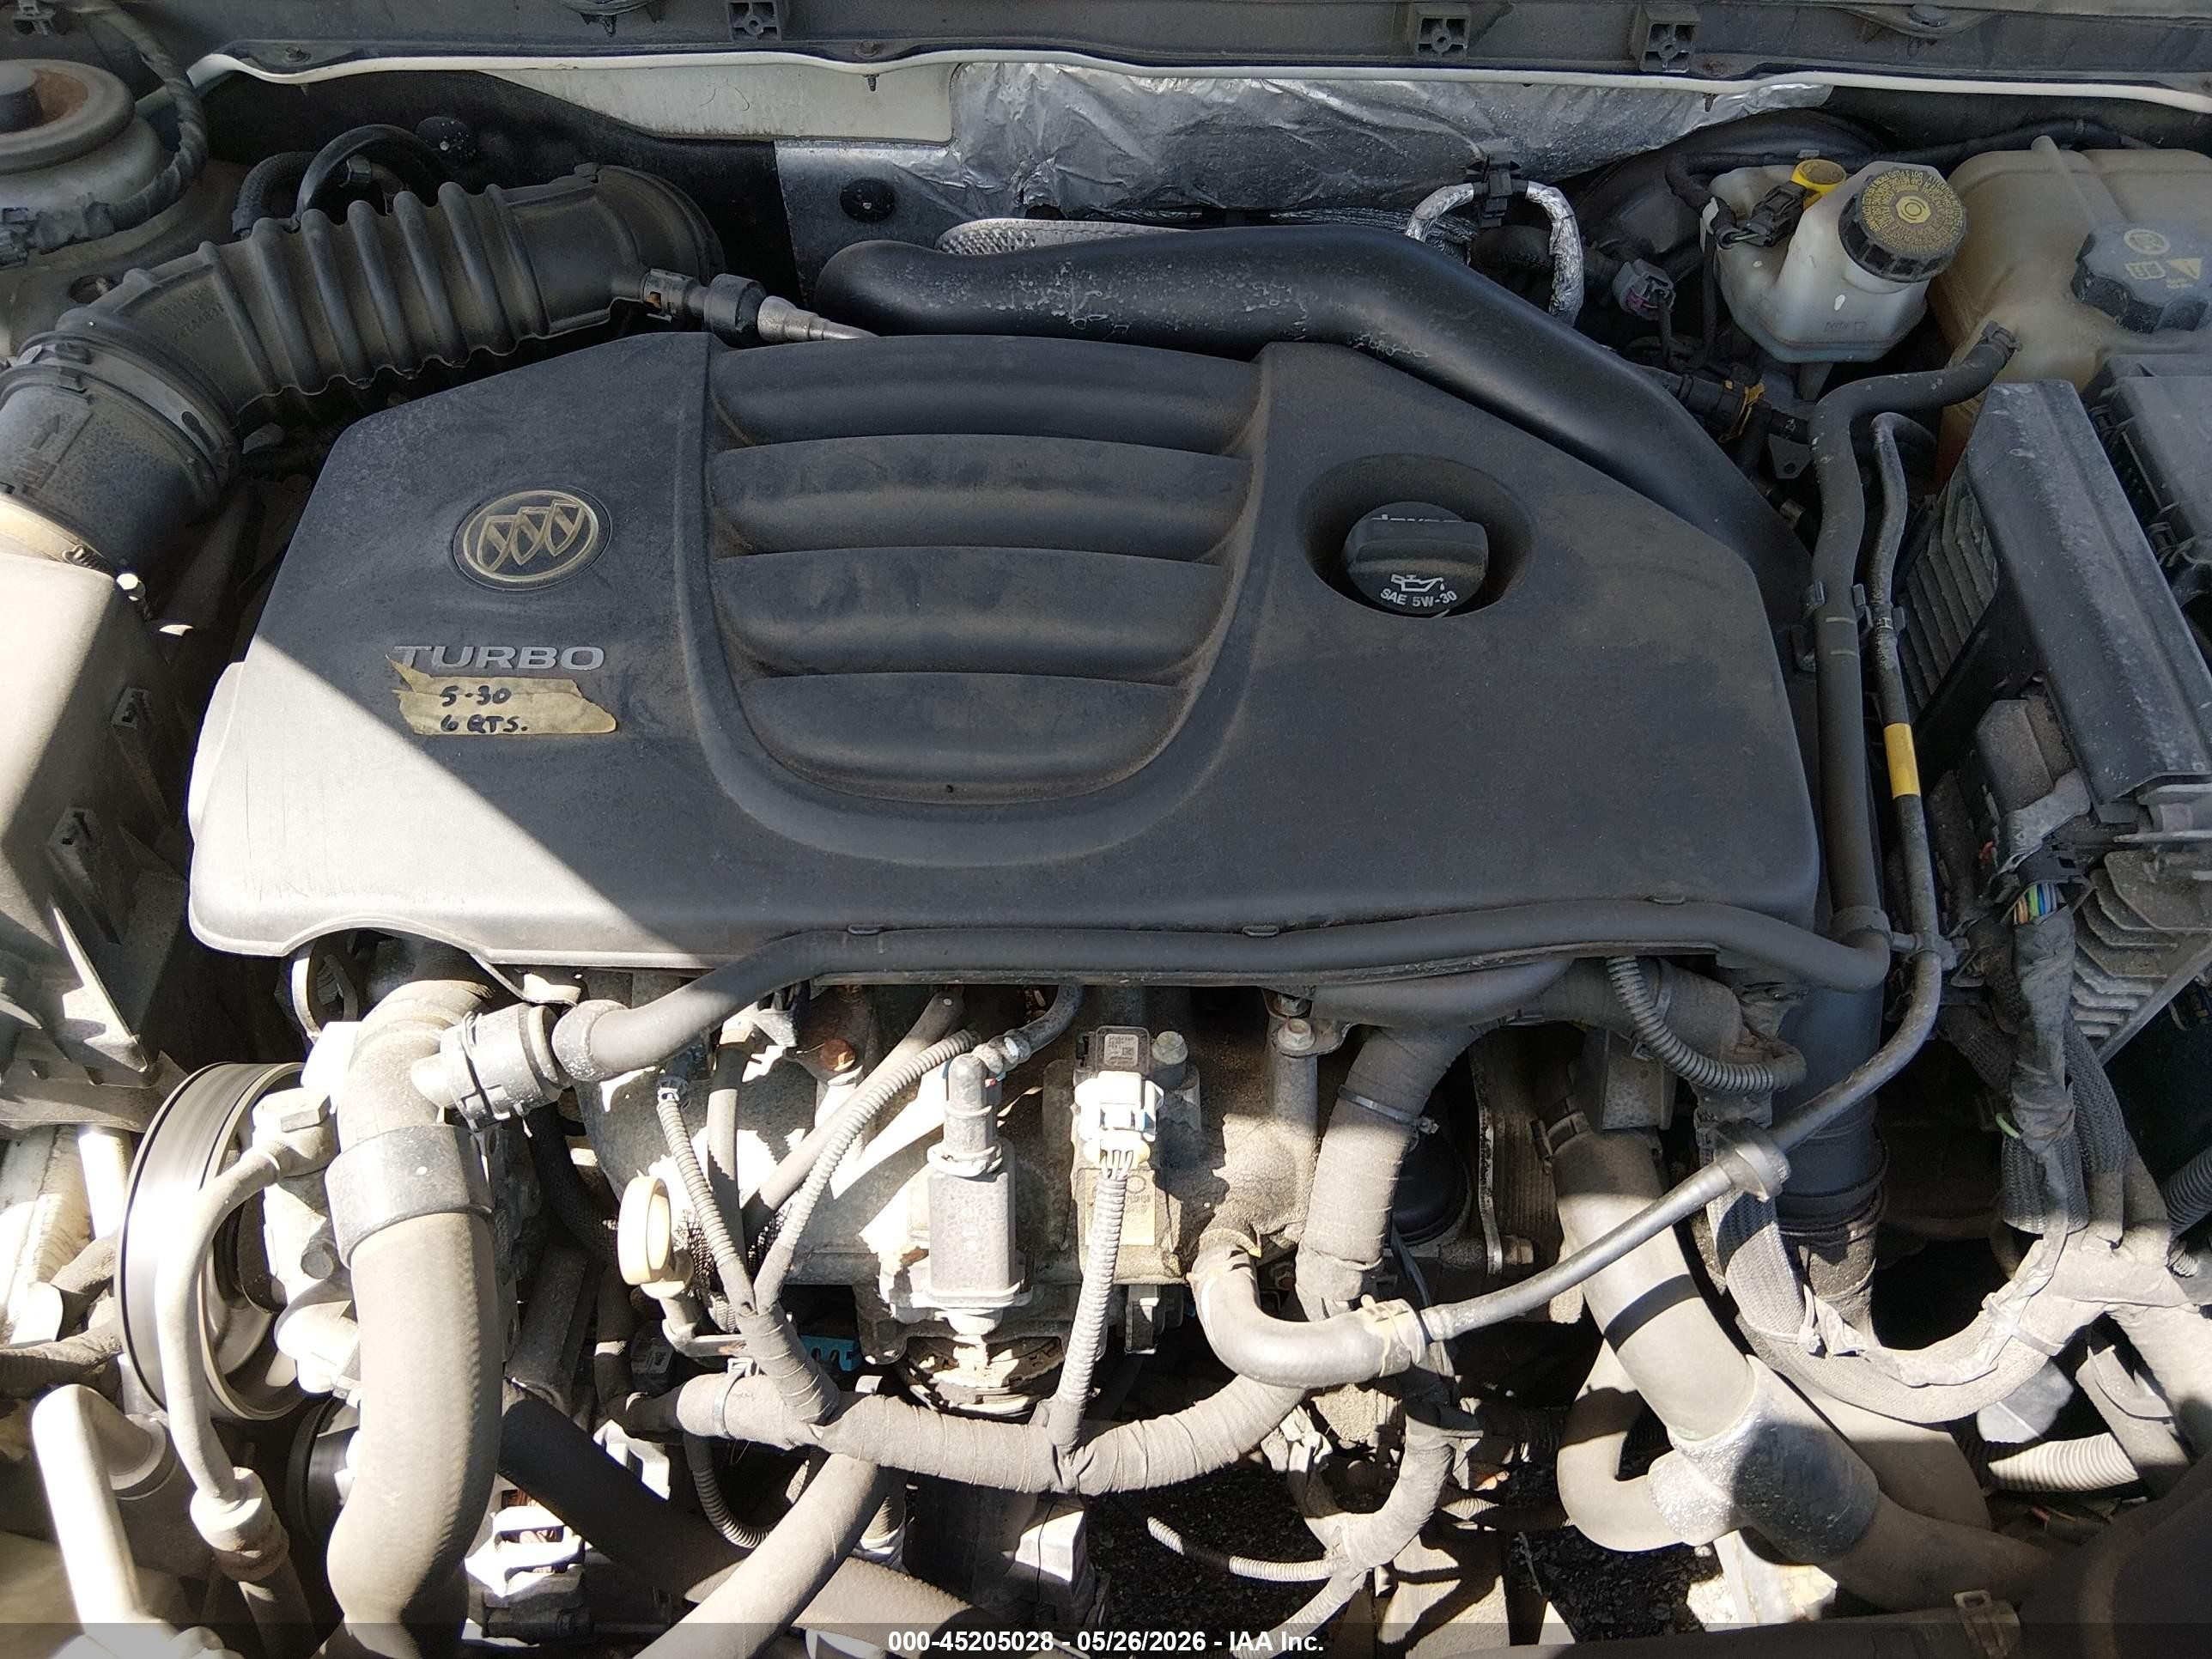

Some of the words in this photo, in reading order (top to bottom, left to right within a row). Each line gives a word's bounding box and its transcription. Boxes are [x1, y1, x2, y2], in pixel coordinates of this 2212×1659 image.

[1381, 588, 1407, 605] SAE
[1412, 590, 1457, 608] 5W-30
[392, 646, 605, 671] TURBO
[440, 685, 512, 707] 5-30
[441, 714, 459, 732] 6
